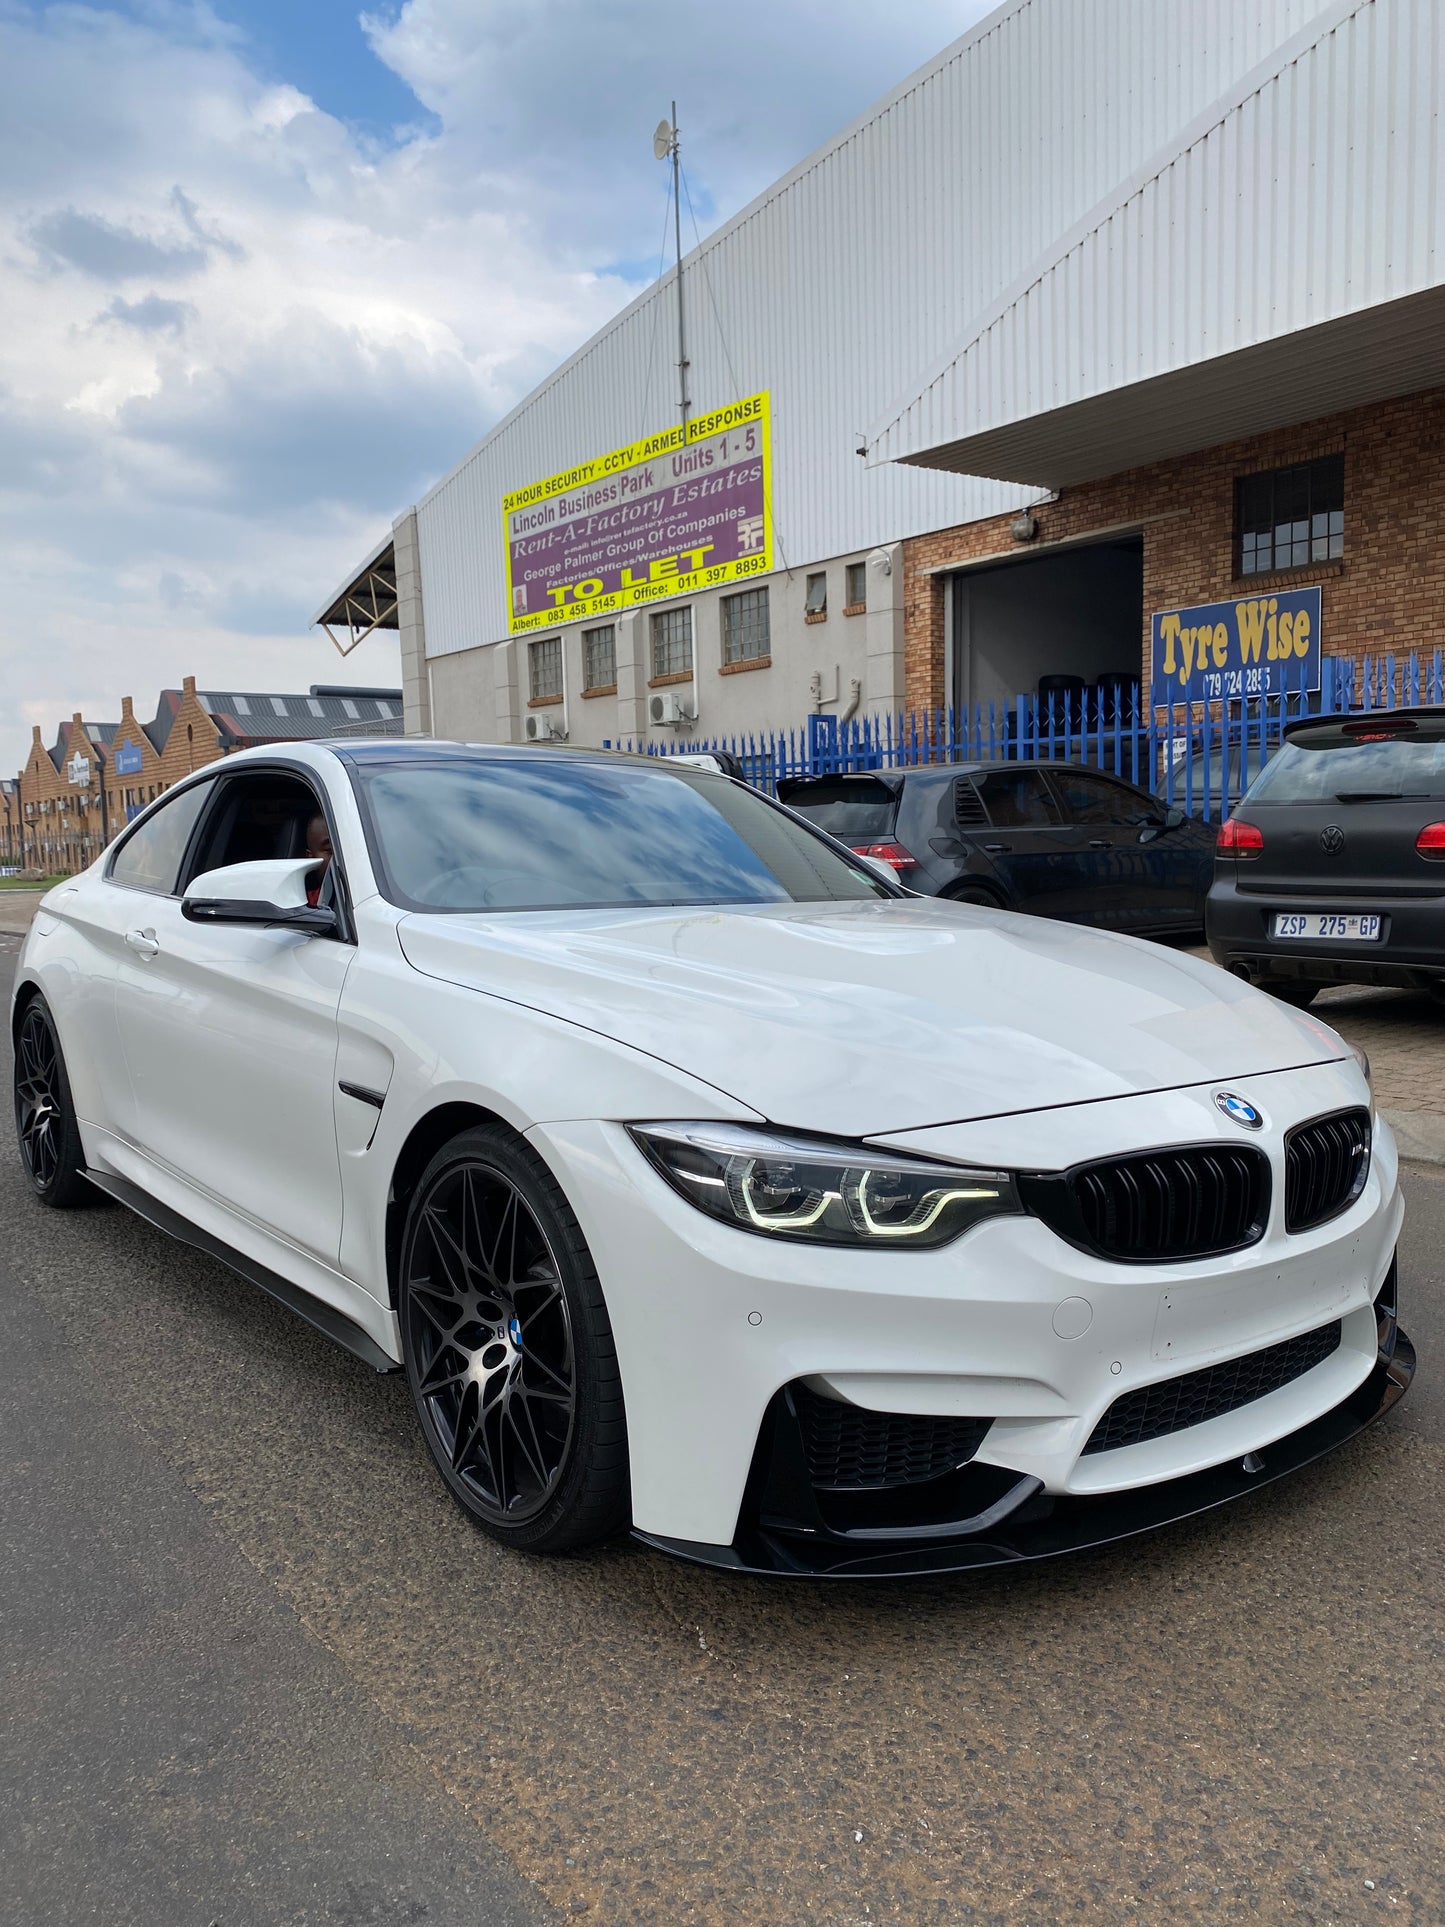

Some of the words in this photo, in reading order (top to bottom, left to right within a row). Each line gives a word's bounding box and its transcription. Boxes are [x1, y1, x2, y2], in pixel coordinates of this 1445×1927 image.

[504, 495, 514, 511] 24
[516, 485, 542, 505] HOUR
[545, 464, 595, 494] SECURITY
[604, 448, 634, 470] CCTV
[643, 428, 684, 456] ARMED
[690, 398, 761, 438] RESPONSE
[513, 505, 555, 534] Lincoln
[559, 484, 617, 518] Business
[621, 467, 653, 496] Park
[672, 447, 713, 477] Units
[720, 437, 727, 460] 1
[746, 427, 755, 452] 5
[513, 497, 665, 559] Rent-A-Factory
[672, 465, 762, 507] Estates
[524, 562, 561, 581] George
[564, 550, 603, 570] Palmer
[607, 539, 644, 557] Group
[648, 529, 664, 544] Of
[667, 506, 746, 538] Companies
[512, 617, 541, 631] Albert:
[548, 609, 564, 622] 083
[569, 603, 587, 617] 458
[592, 596, 615, 611] 5145
[633, 584, 668, 600] Office:
[678, 573, 698, 589] 011
[706, 567, 727, 583] 397
[735, 556, 767, 575] 8893
[546, 534, 713, 588] Factories/Offices/Warehouses
[547, 578, 604, 606] TO
[621, 544, 714, 589] LET
[1160, 613, 1228, 686] Tyre
[1235, 598, 1311, 665] Wise
[1280, 916, 1307, 935] ZSP
[1319, 916, 1347, 936] 275
[1360, 916, 1378, 936] GP
